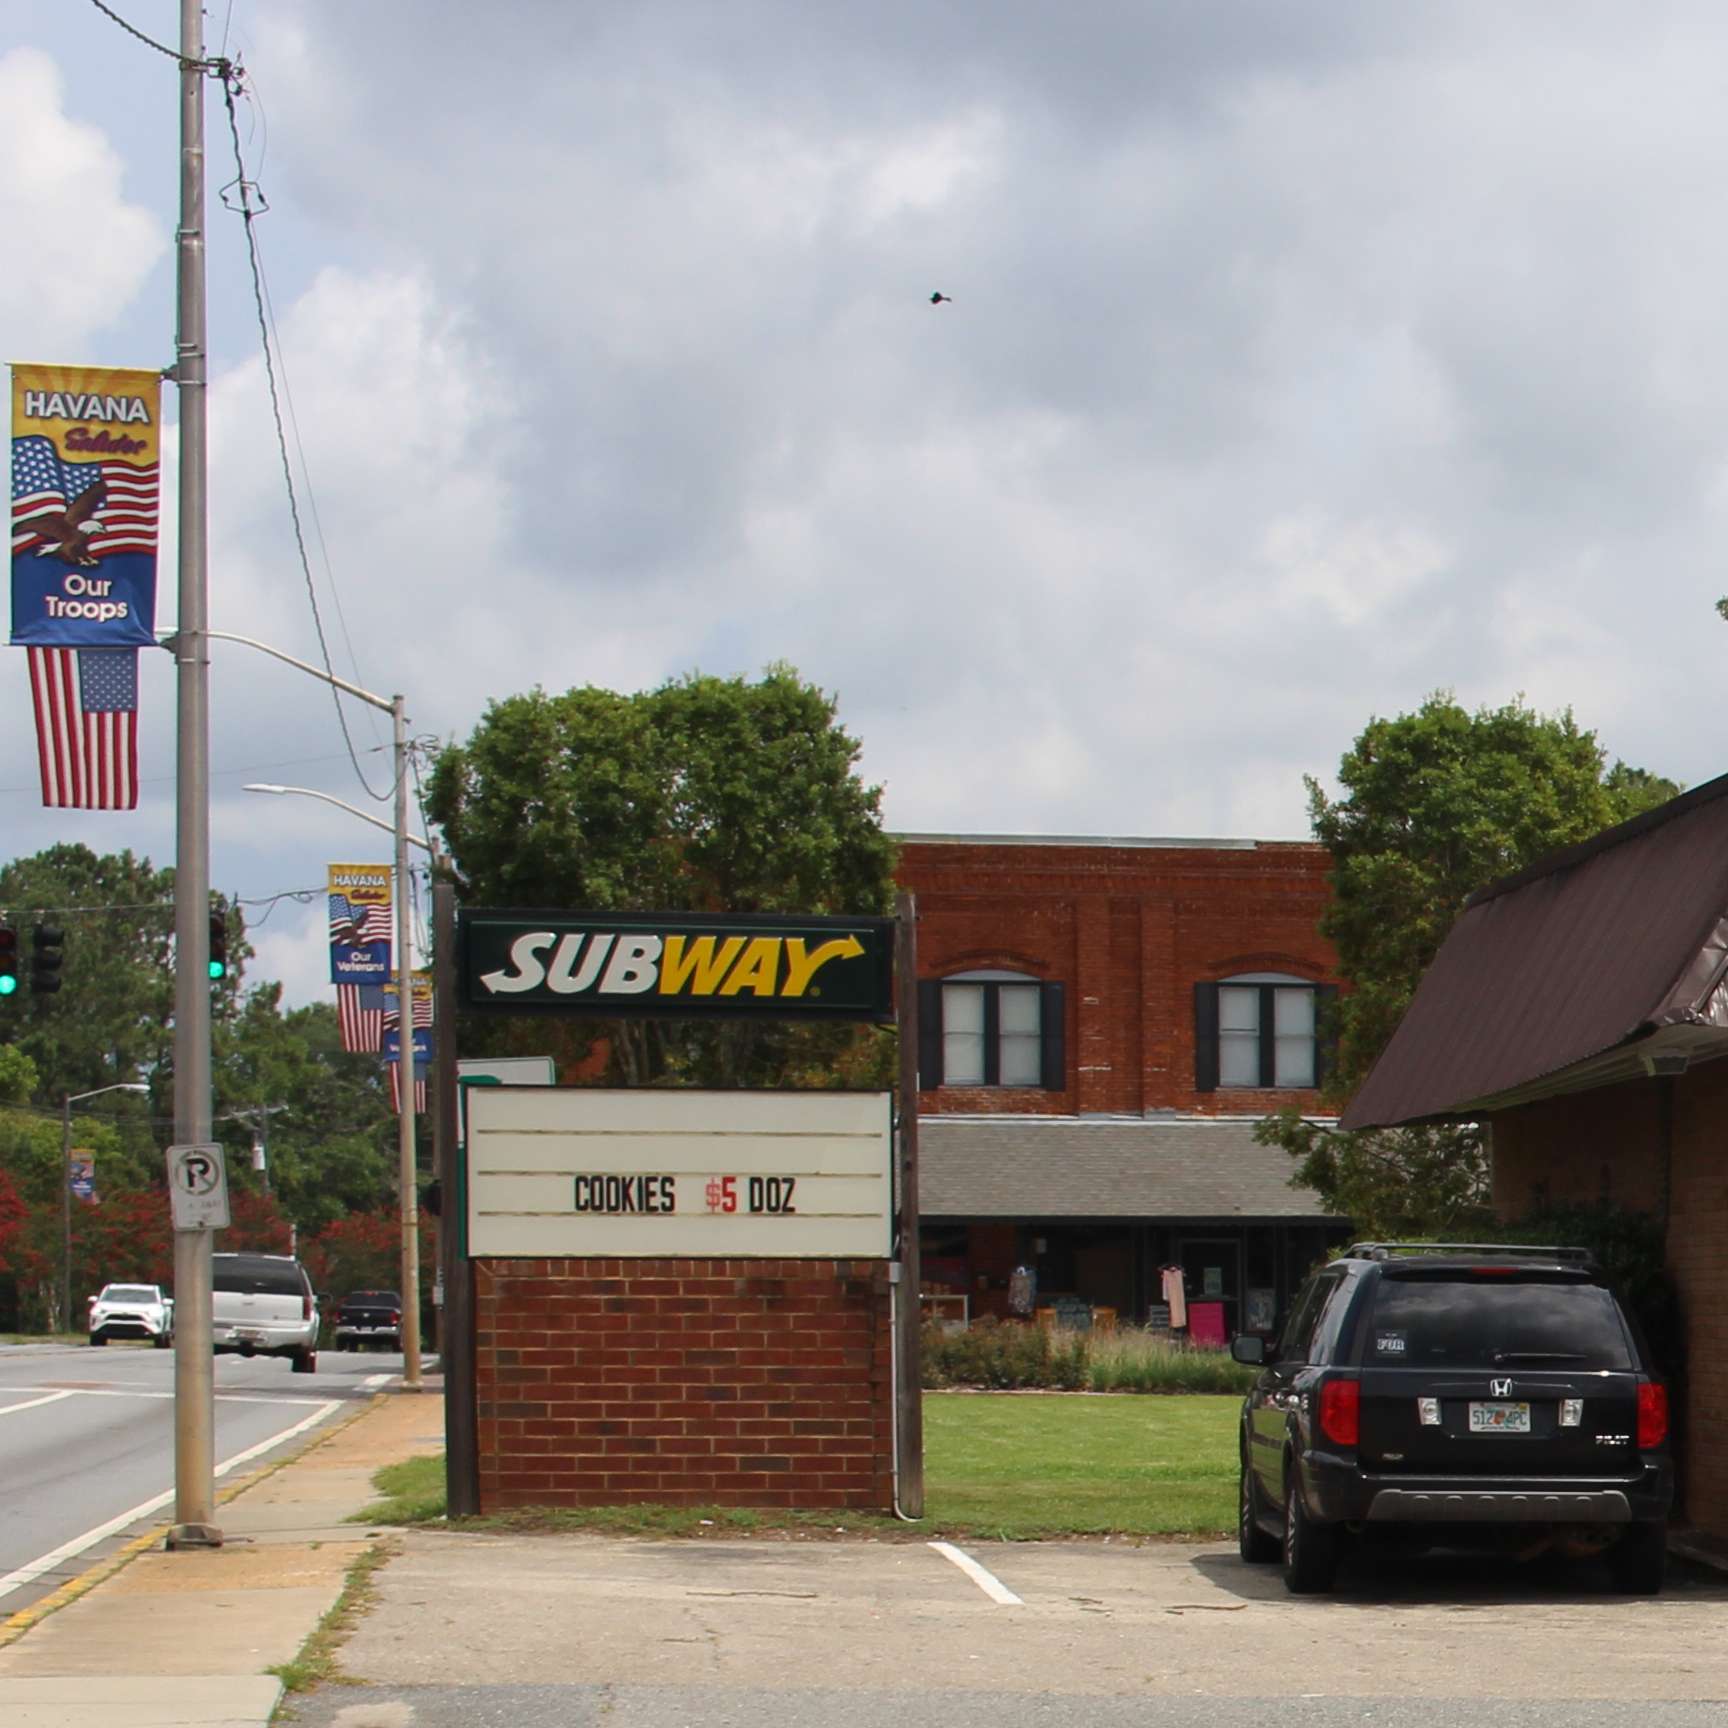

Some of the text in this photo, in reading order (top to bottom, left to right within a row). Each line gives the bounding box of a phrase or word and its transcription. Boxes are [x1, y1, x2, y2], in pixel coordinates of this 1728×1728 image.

[24, 391, 150, 424] HAVANA
[63, 573, 113, 598] Our
[45, 595, 129, 623] Troops
[333, 874, 386, 888] HAVANA
[336, 960, 385, 972] Veterans
[350, 951, 372, 963] Our
[480, 932, 865, 997] SUBWAY
[575, 1175, 796, 1214] COOKIES $5 DOZ
